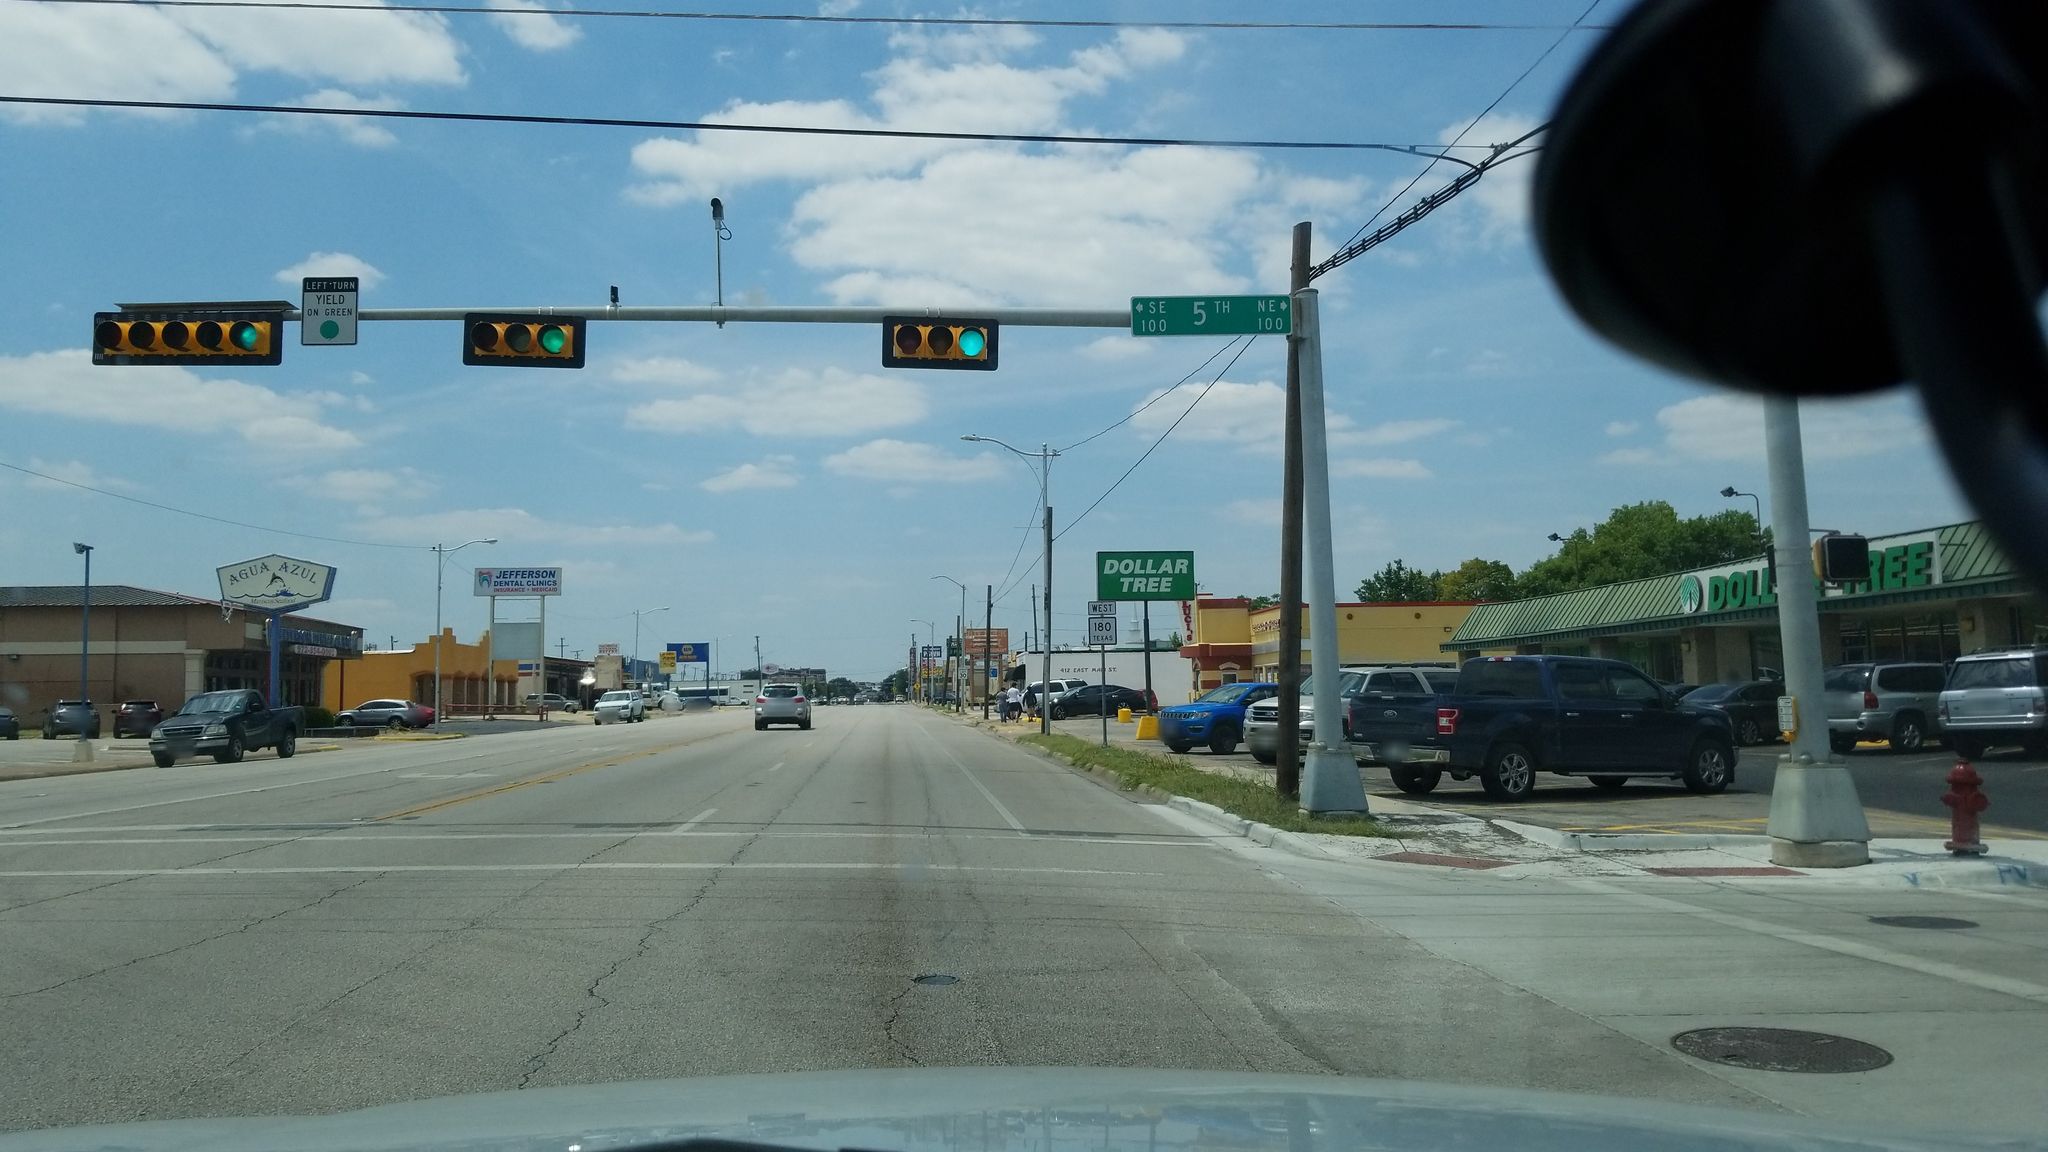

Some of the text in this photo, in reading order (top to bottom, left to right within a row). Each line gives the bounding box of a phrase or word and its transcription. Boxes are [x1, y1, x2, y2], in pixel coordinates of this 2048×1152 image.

[306, 281, 355, 290] LEFT TURN
[316, 294, 345, 305] YIELD
[307, 308, 353, 317] ON GREEN
[1148, 301, 1167, 314] SE
[1257, 300, 1276, 313] NE
[1193, 301, 1230, 326] 5 TH
[1142, 319, 1167, 332] 100
[1258, 317, 1283, 331] 100
[1103, 558, 1189, 575] DOLLAR
[1843, 541, 1931, 595] REE
[229, 561, 318, 586] AGUA AZUL
[495, 570, 556, 579] JEFFERSON
[1120, 577, 1173, 593] TREE
[1091, 604, 1113, 613] WEST
[1093, 622, 1112, 632] 180
